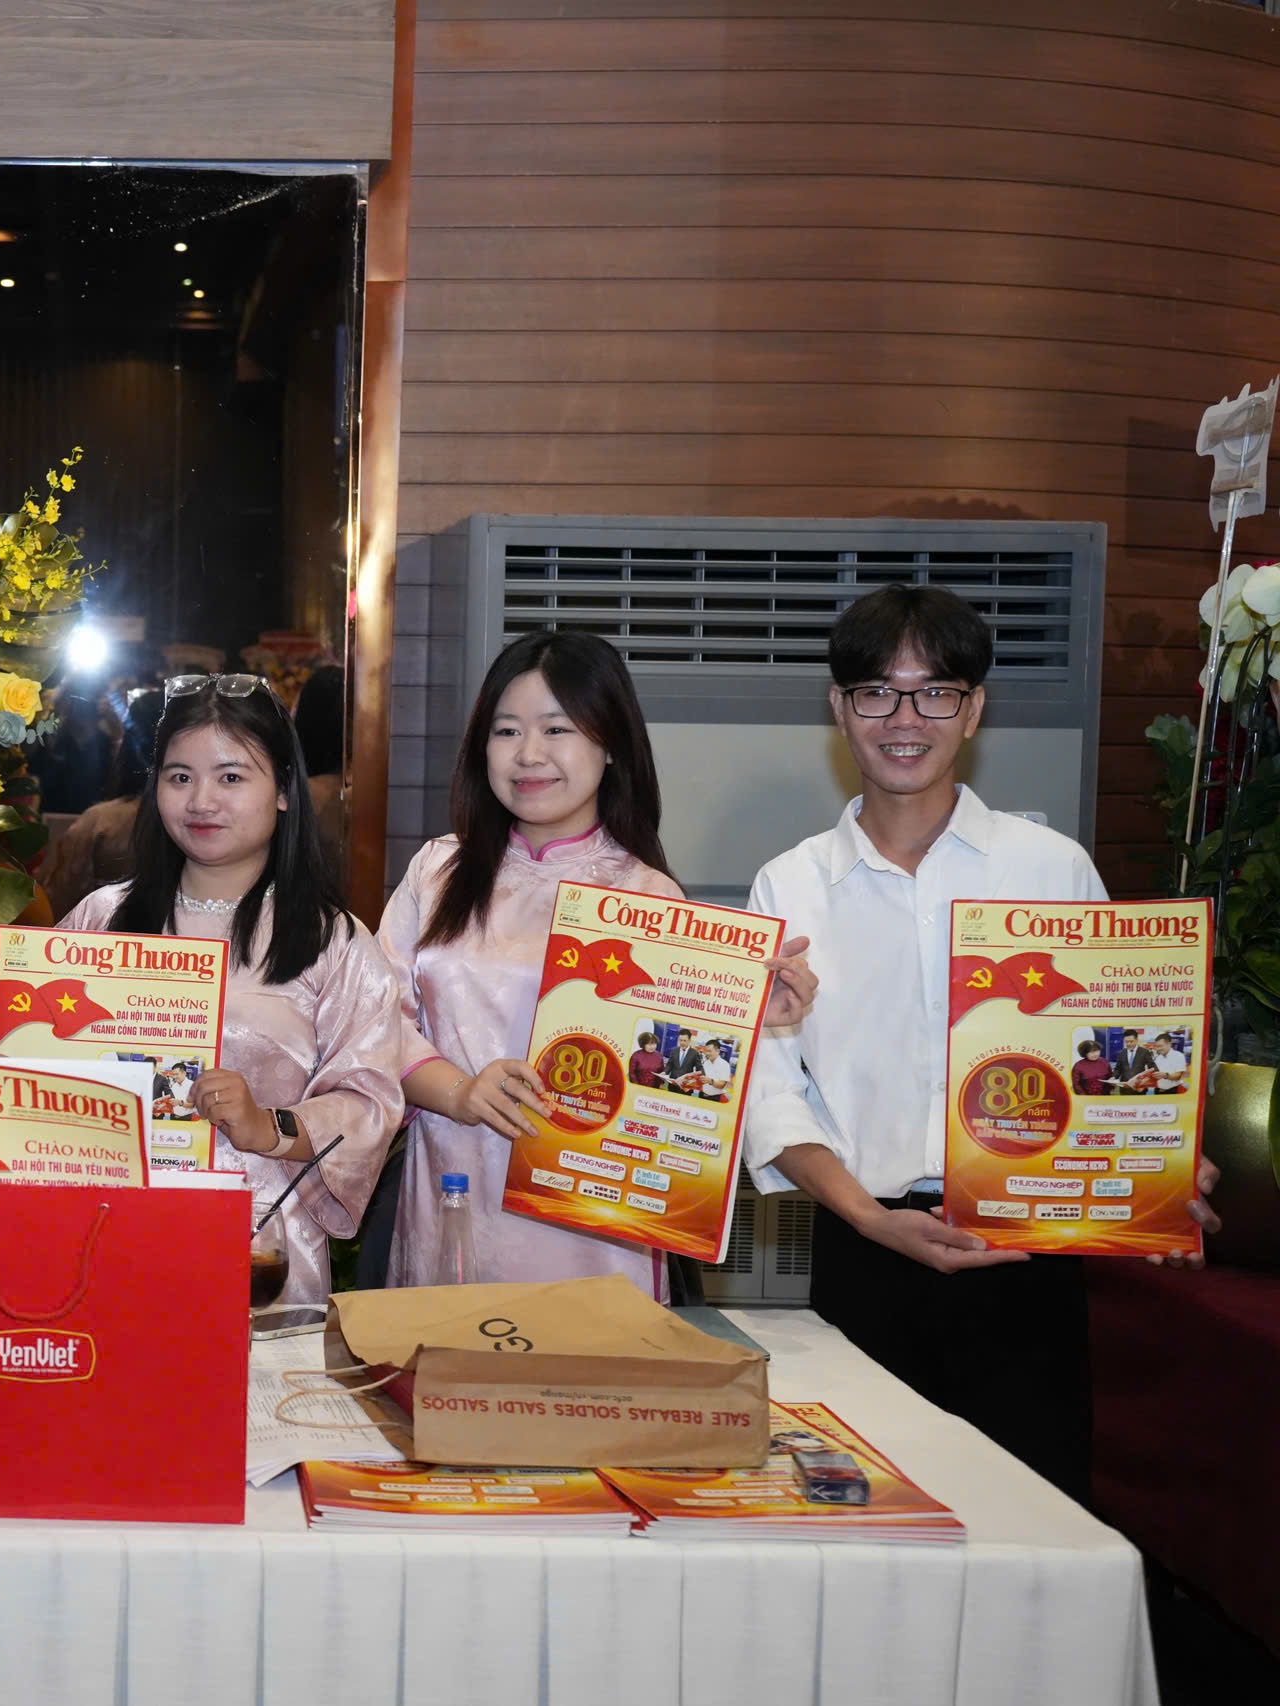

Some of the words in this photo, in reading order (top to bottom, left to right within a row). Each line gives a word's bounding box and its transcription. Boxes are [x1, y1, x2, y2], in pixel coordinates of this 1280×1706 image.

[598, 896, 664, 938] Công
[665, 906, 769, 958] Thương
[1005, 908, 1083, 945] Công
[1085, 911, 1199, 943] Thương
[45, 936, 114, 974] Công
[115, 942, 215, 979] Thương
[670, 963, 708, 980] CHÀO
[711, 971, 754, 989] MỪNG
[1102, 964, 1143, 977] CHÀO
[1149, 963, 1193, 976] MỪNG
[657, 977, 670, 989] ĐẠI
[671, 979, 684, 992] HỘI
[685, 982, 697, 993] THI
[698, 985, 712, 996] ĐUA
[713, 987, 728, 999] YÊU
[728, 990, 749, 1003] NƯỚC
[1090, 983, 1103, 994] ĐẠI
[1106, 980, 1119, 994] HỘI
[1122, 982, 1134, 992] THI
[1136, 982, 1152, 991] ĐUA
[1154, 980, 1169, 991] YÊU
[1172, 980, 1193, 991] NƯỚC
[128, 995, 164, 1008] CHÀO
[169, 996, 208, 1010] MỪNG
[629, 987, 655, 1001] NGÀNH
[656, 993, 676, 1006] CÔNG
[677, 997, 706, 1011] THƯƠNG
[706, 1001, 722, 1014] LẦN
[722, 1005, 737, 1017] THỨ
[738, 1008, 745, 1018] IV
[1061, 997, 1089, 1008] NGÀNH
[1092, 997, 1114, 1008] CÔNG
[1117, 999, 1147, 1008] THƯƠNG
[1150, 995, 1166, 1008] LẦN
[1168, 996, 1184, 1007] THỨ
[1186, 997, 1193, 1006] IV
[117, 1011, 129, 1021] ĐẠI
[131, 1010, 142, 1022] HỘI
[145, 1012, 155, 1022] THI
[157, 1013, 171, 1022] ĐUA
[173, 1012, 186, 1023] YÊU
[188, 1013, 207, 1024] NƯỚC
[91, 1023, 116, 1034] NGÀNH
[118, 1024, 137, 1036] CÔNG
[139, 1027, 167, 1038] THƯƠNG
[168, 1027, 183, 1039] LẦN
[184, 1028, 198, 1039] THỨ
[200, 1030, 206, 1039] IV
[549, 1044, 607, 1091] 80
[587, 1090, 606, 1098] năm
[979, 1067, 1045, 1115] 80
[3, 1076, 131, 1131] Thương
[25, 1139, 74, 1156] CHÀO
[78, 1143, 129, 1163] MỪNG
[13, 1158, 28, 1171] ĐẠI
[31, 1158, 46, 1173] HỘI
[49, 1161, 62, 1173] THI
[65, 1163, 82, 1175] ĐUA
[85, 1163, 102, 1176] YÊU
[105, 1164, 130, 1179] NƯỚC
[0, 1336, 79, 1368] YenViet
[422, 1395, 489, 1413] SALDOS
[497, 1400, 547, 1416] SALDI
[555, 1404, 621, 1419] SOLDES
[628, 1407, 704, 1424] REBAJAS
[712, 1411, 751, 1427] SALE
